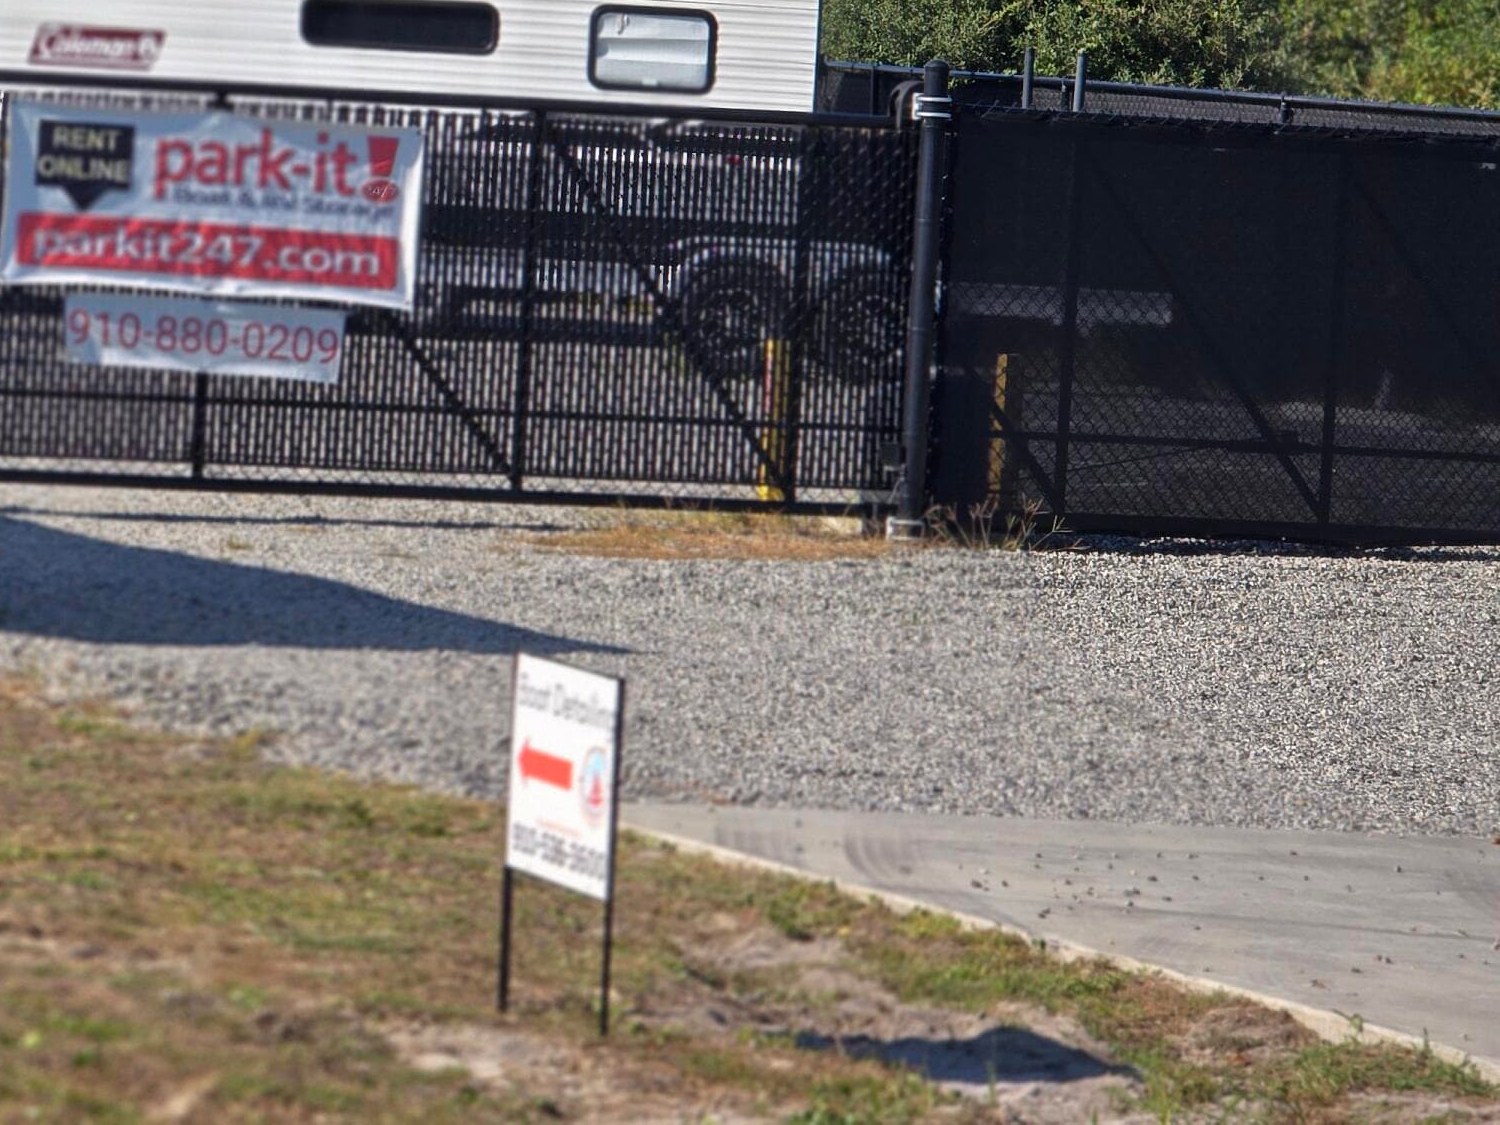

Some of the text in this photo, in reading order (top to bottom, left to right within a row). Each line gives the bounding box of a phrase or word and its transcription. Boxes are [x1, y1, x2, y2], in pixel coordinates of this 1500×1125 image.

[52, 125, 120, 151] RENT
[37, 155, 128, 183] ONLINE
[32, 227, 380, 277] parkit247.com
[67, 308, 339, 365] 910-880-0209
